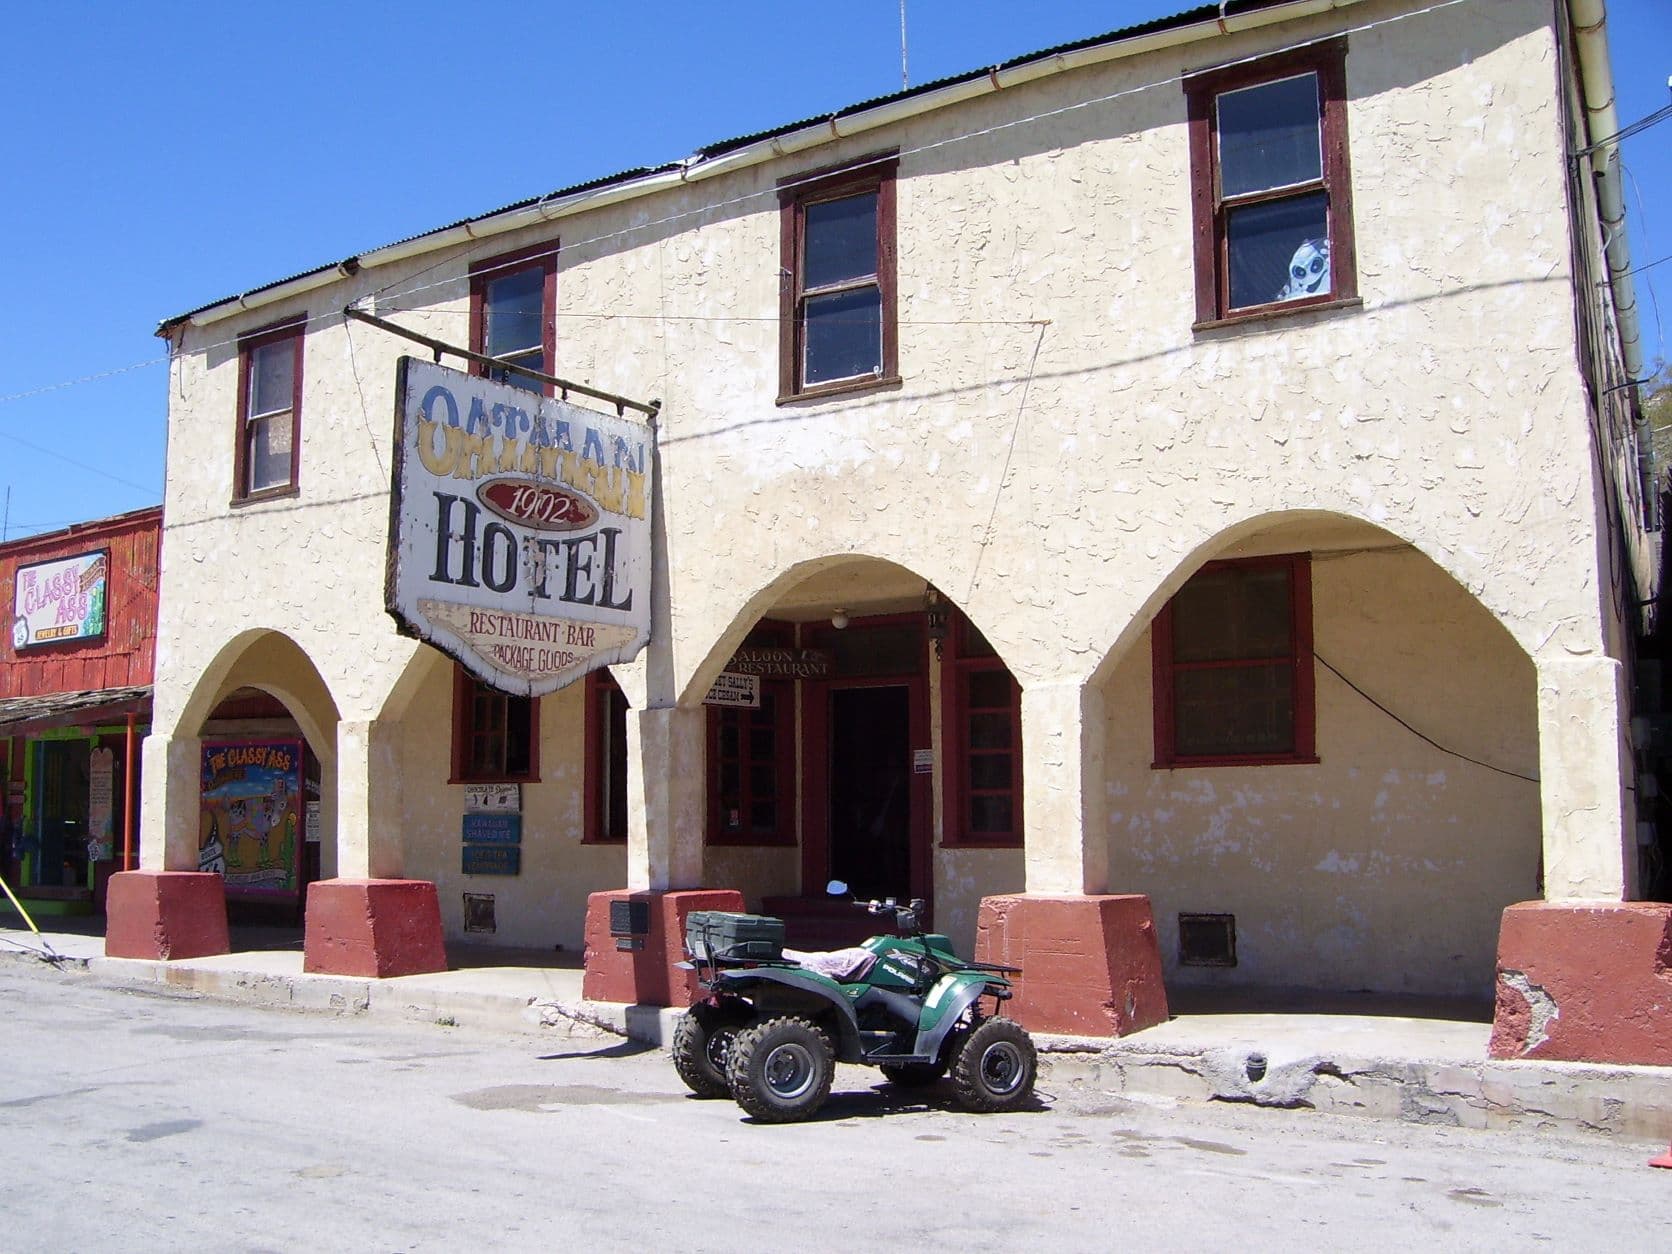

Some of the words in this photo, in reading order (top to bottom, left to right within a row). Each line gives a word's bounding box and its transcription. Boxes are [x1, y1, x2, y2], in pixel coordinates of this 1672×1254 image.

[418, 385, 646, 521] OATMAN
[509, 486, 570, 524] 1902
[428, 490, 633, 612] HOTEL
[23, 569, 37, 591] THE
[25, 563, 80, 615] CLASSY
[55, 592, 87, 624] ASS
[469, 611, 560, 643] RESTAURANT
[567, 626, 596, 647] BAR
[493, 643, 536, 672] PACKAGE
[538, 650, 574, 673] GOODS
[739, 663, 829, 678] RESTAURANT
[210, 752, 226, 775] THE
[228, 746, 268, 768] CLASSY
[269, 750, 291, 771] ASS
[883, 965, 917, 985] POLARIS
